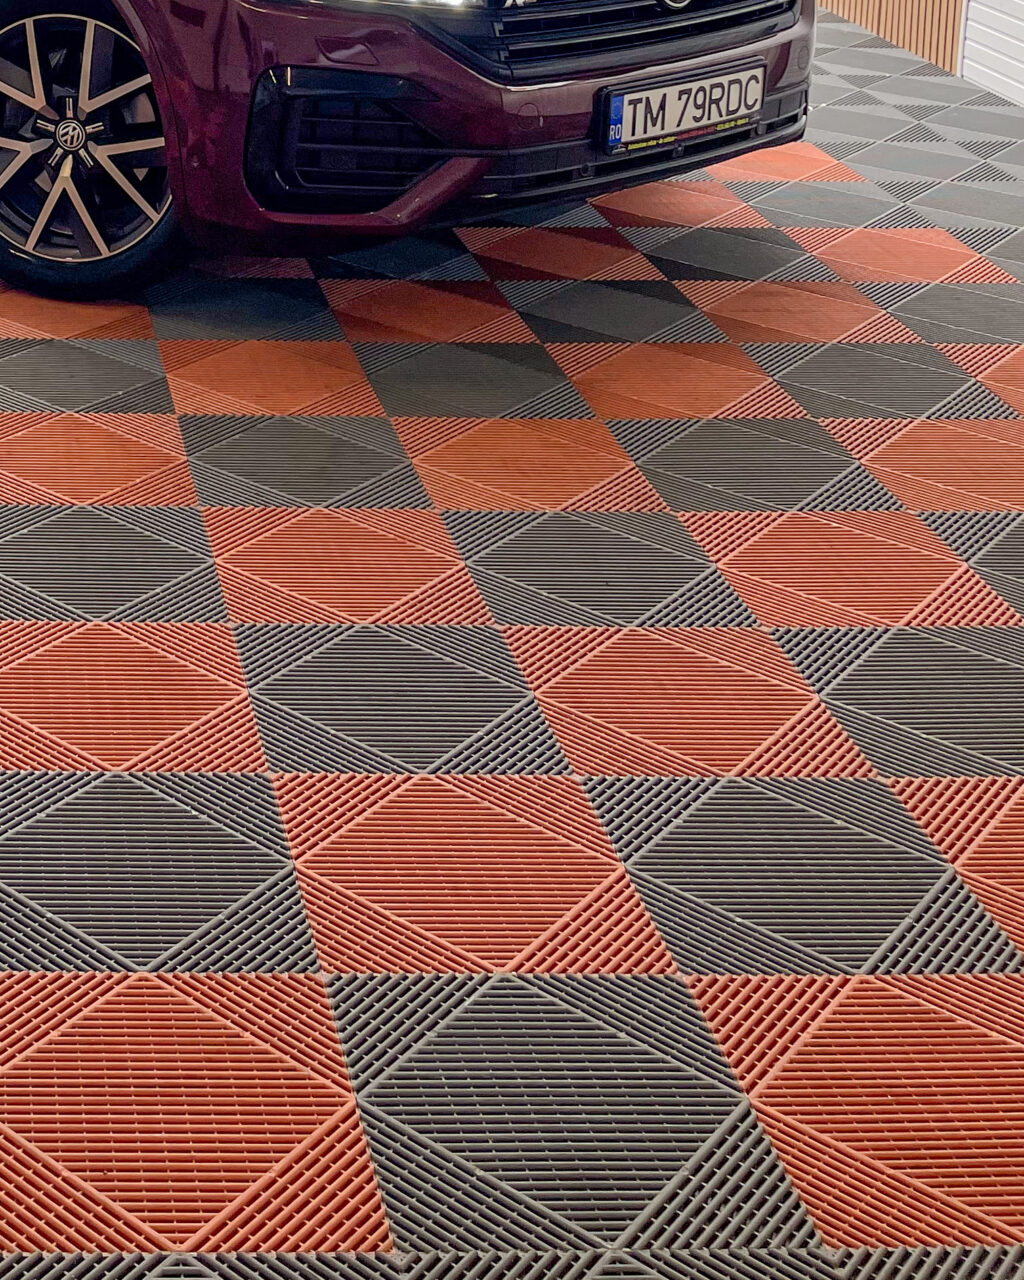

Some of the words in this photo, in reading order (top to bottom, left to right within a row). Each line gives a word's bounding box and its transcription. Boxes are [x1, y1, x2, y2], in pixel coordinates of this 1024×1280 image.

[628, 93, 667, 137] TM
[676, 74, 760, 128] 79RDC
[609, 123, 622, 140] RO
